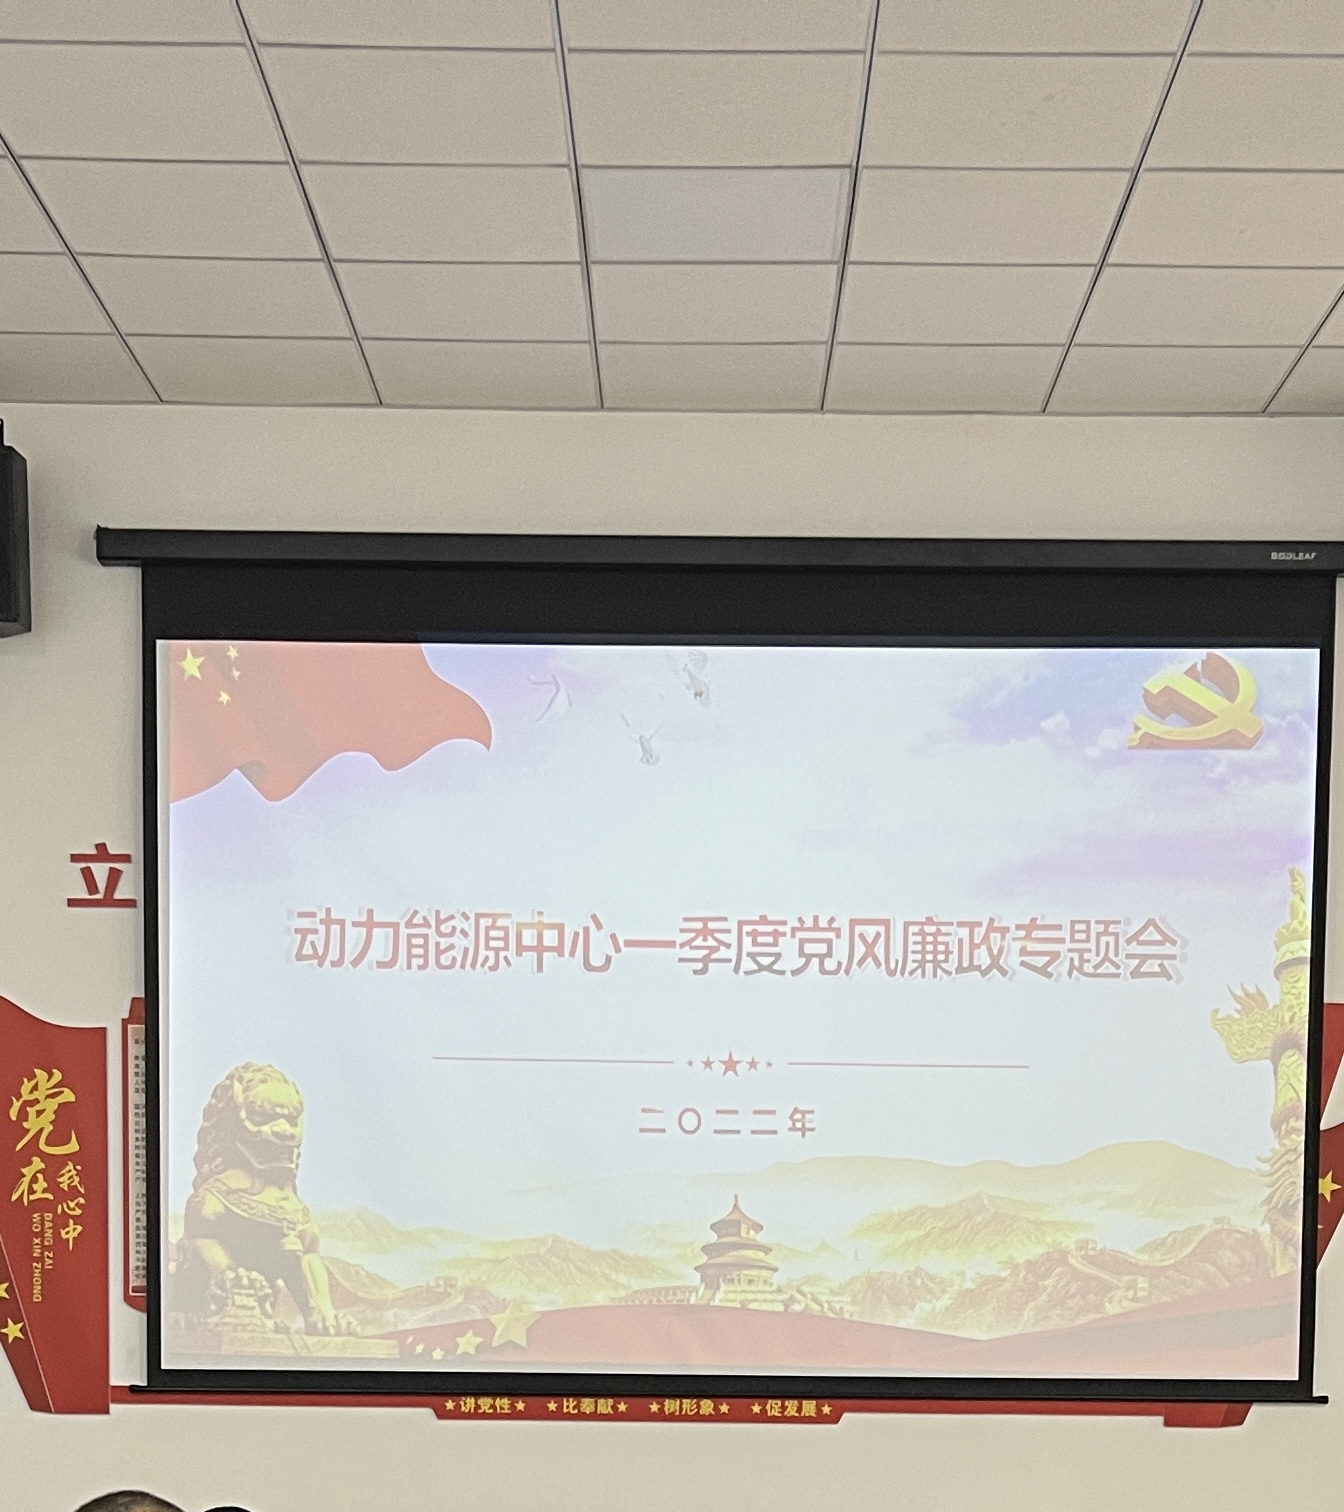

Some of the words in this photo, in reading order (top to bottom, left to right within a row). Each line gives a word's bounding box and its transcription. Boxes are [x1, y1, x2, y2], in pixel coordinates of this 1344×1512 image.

[67, 842, 138, 908] 立
[294, 906, 1179, 984] 动力能源中心一季度党风廉政专题会
[32, 1212, 43, 1232] WO
[43, 1212, 54, 1246] DANG
[32, 1237, 43, 1257] XIN
[43, 1250, 54, 1270] ZAI
[31, 1262, 43, 1302] ZHONG
[459, 1396, 512, 1415] 讲党性
[562, 1397, 614, 1416] 比奉献
[663, 1398, 716, 1417] 树形象
[765, 1400, 818, 1418] 促发展
